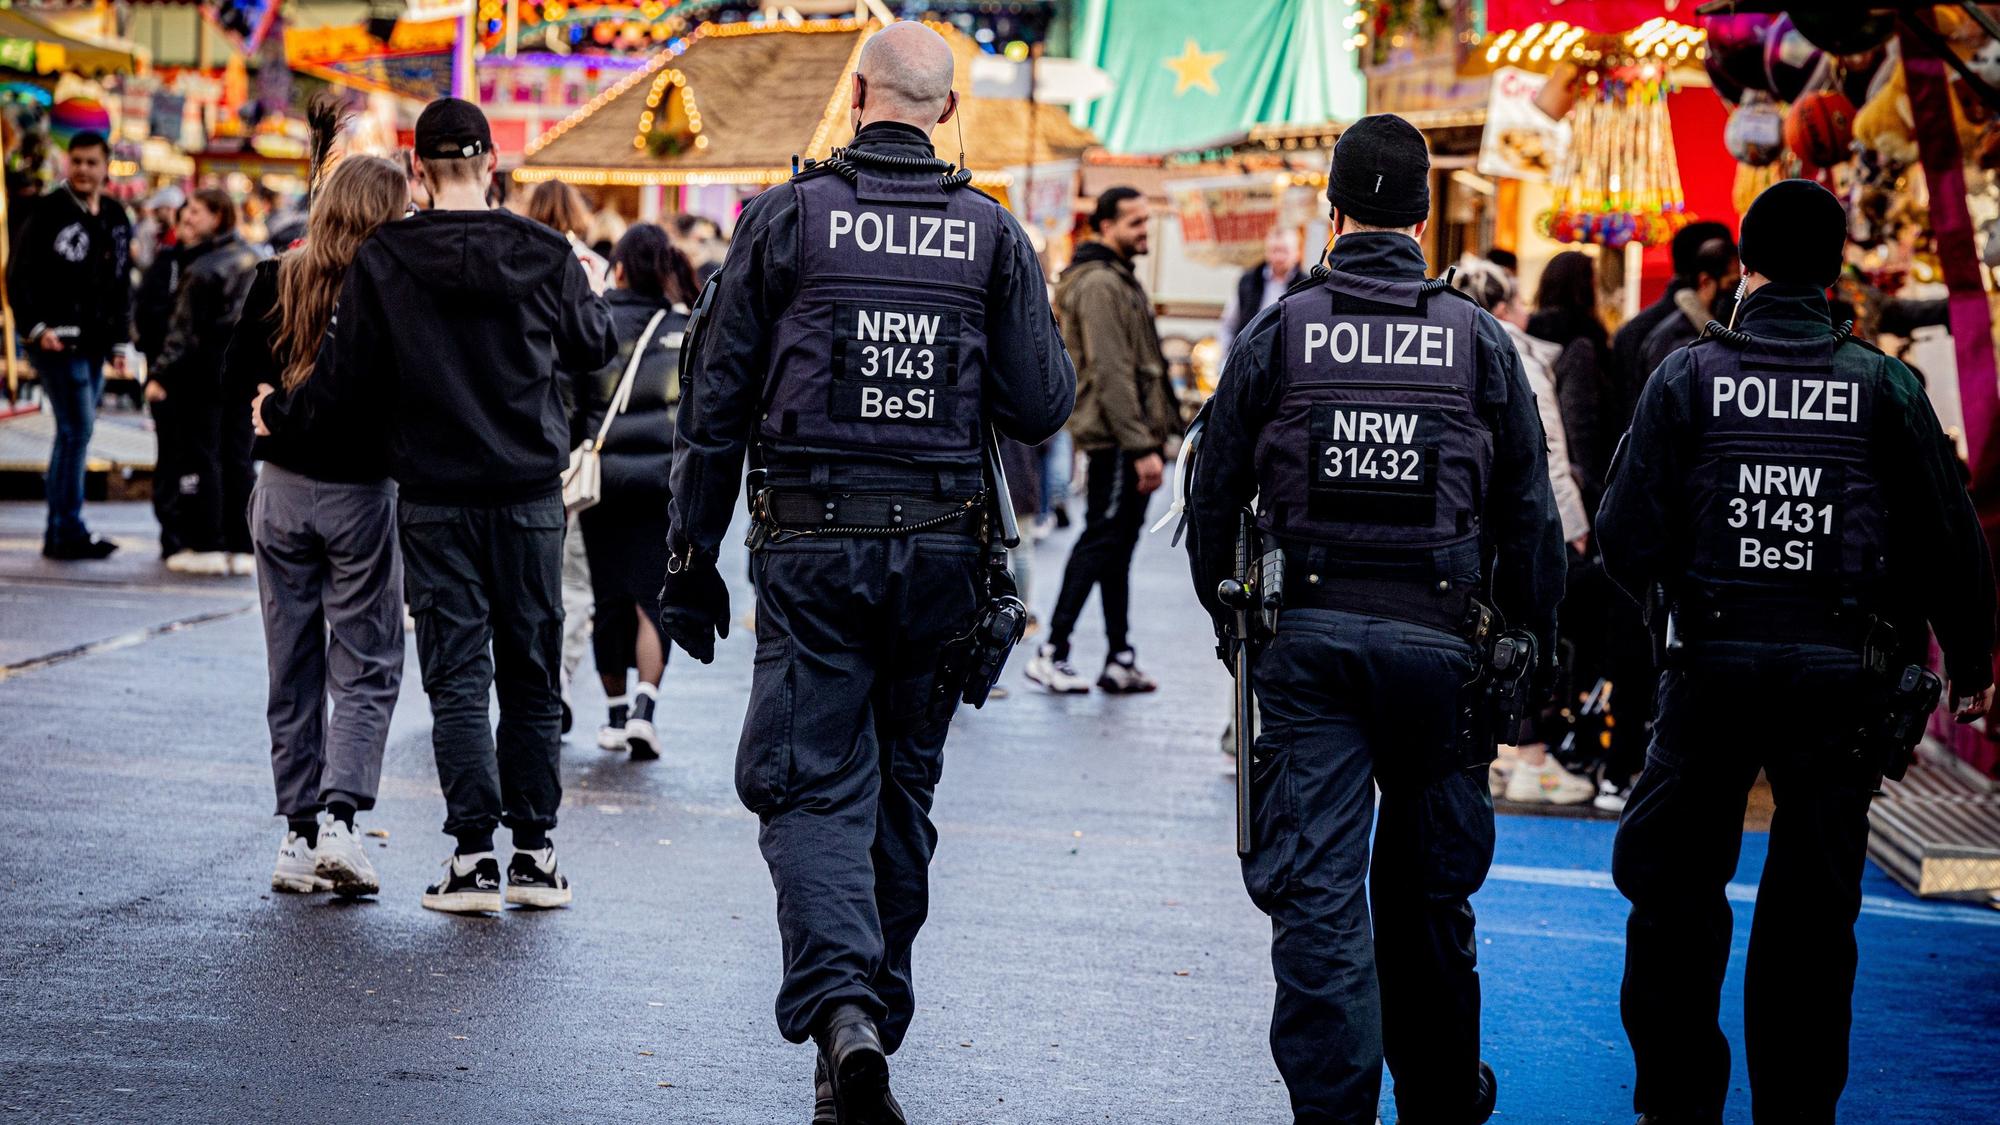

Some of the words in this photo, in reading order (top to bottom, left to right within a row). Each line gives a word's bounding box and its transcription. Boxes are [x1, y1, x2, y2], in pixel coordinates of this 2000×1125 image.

[829, 210, 976, 261] POLIZEI
[857, 309, 941, 345] NRW
[1304, 321, 1454, 367] POLIZEI
[860, 345, 935, 381] 3143
[860, 387, 936, 420] BeSi
[1713, 376, 1859, 423] POLIZEI
[1333, 409, 1419, 444] NRW
[1323, 446, 1420, 483] 31432
[1738, 463, 1823, 497] NRW
[1727, 497, 1833, 535] 31431
[1739, 537, 1814, 571] BeSi
